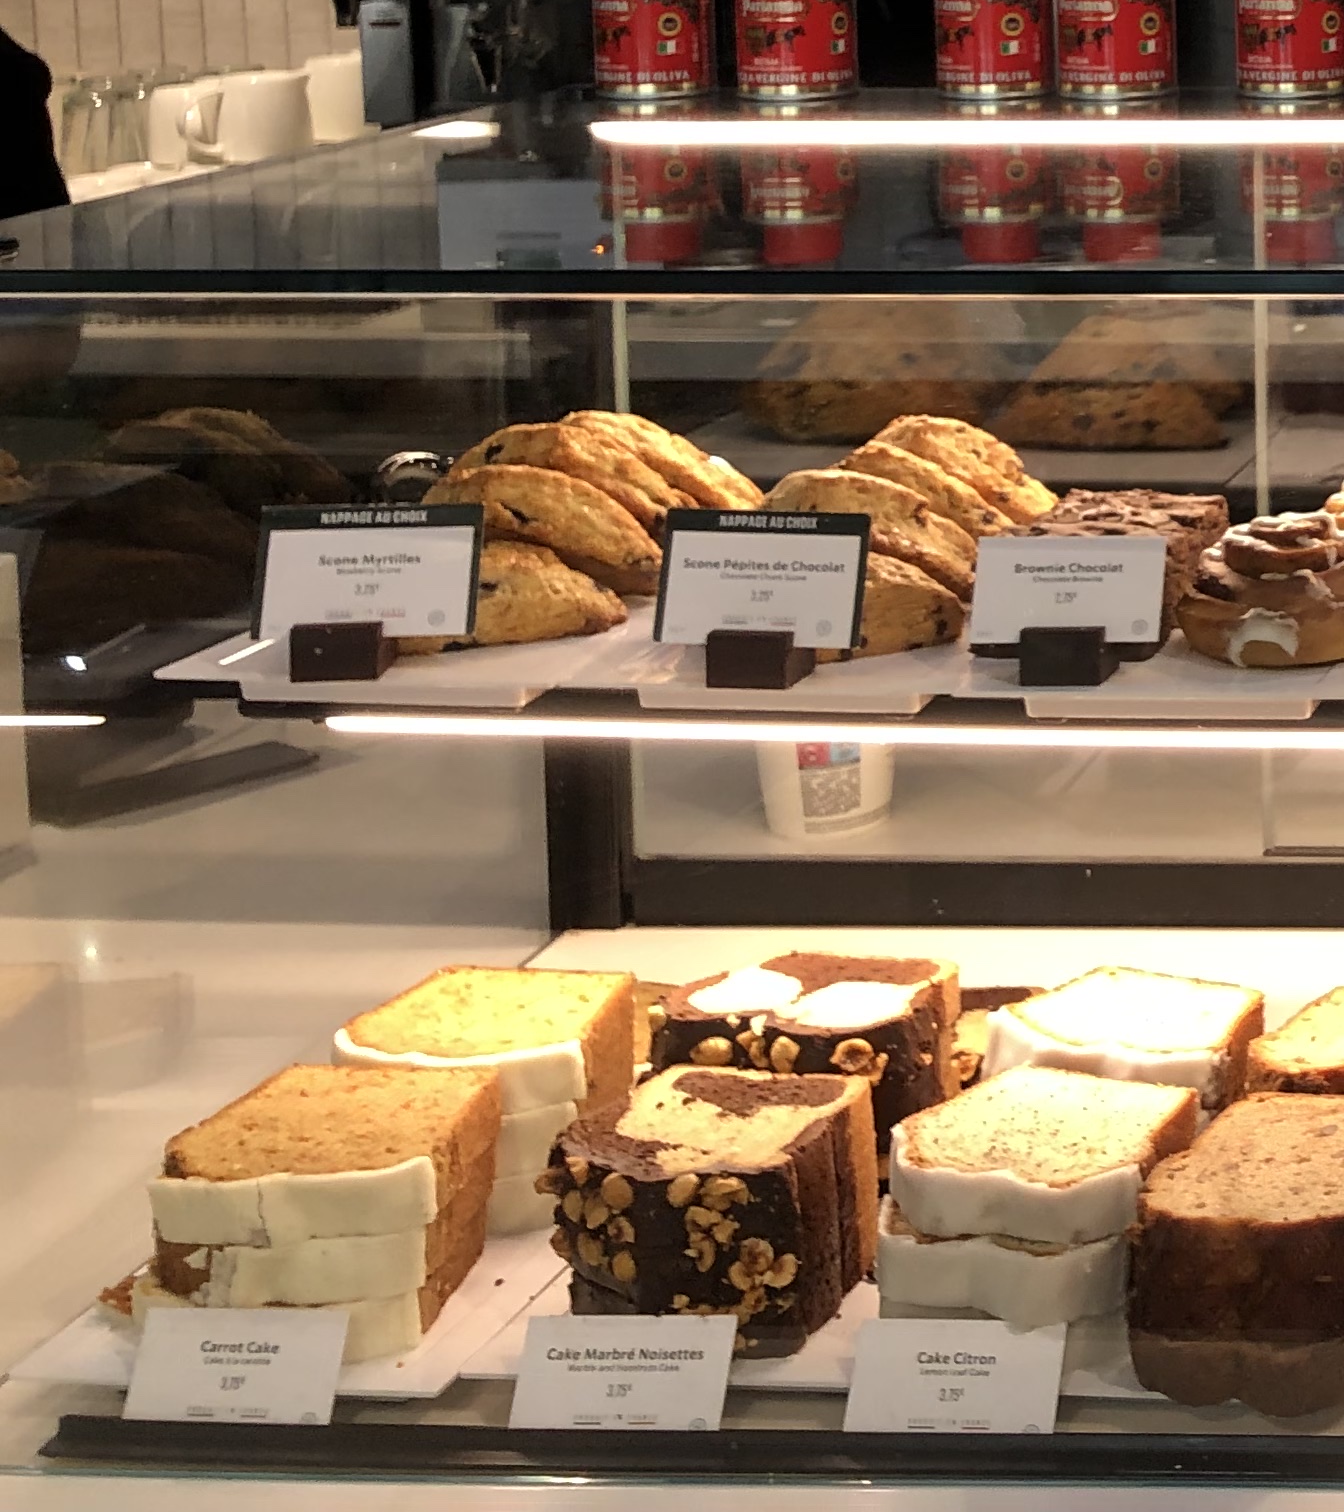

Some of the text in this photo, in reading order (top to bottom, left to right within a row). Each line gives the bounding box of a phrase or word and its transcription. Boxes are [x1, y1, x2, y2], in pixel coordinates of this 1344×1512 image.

[684, 557, 720, 570] Scone
[773, 561, 787, 571] de
[791, 561, 845, 573] Chocolat
[201, 1341, 279, 1354] Carrot Cake
[547, 1348, 704, 1361] Cake Marbré Noisettes
[917, 1352, 997, 1365] Cake Citron
